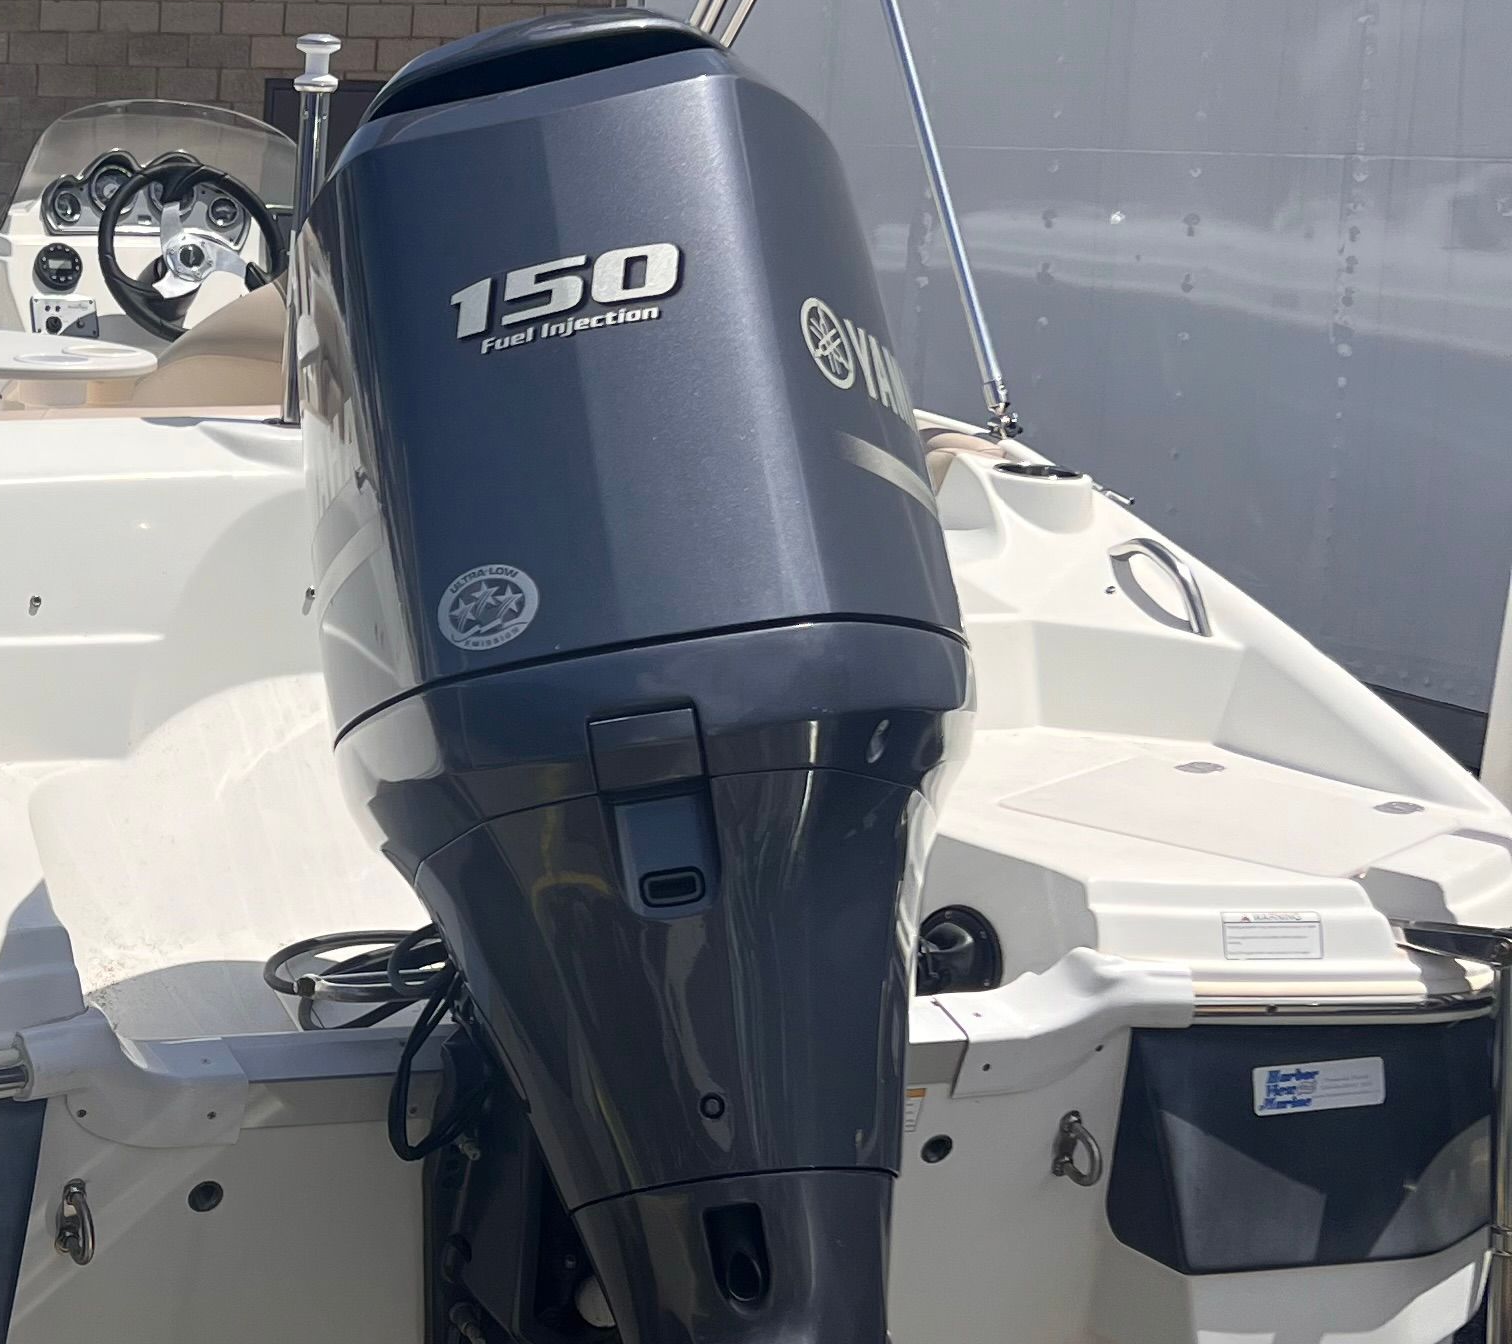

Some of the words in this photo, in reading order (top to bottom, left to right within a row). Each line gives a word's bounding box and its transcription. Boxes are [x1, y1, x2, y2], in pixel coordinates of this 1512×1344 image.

[449, 242, 680, 339] 150
[480, 326, 534, 355] Fuel
[540, 305, 660, 338] Injection
[842, 318, 917, 432] YAM
